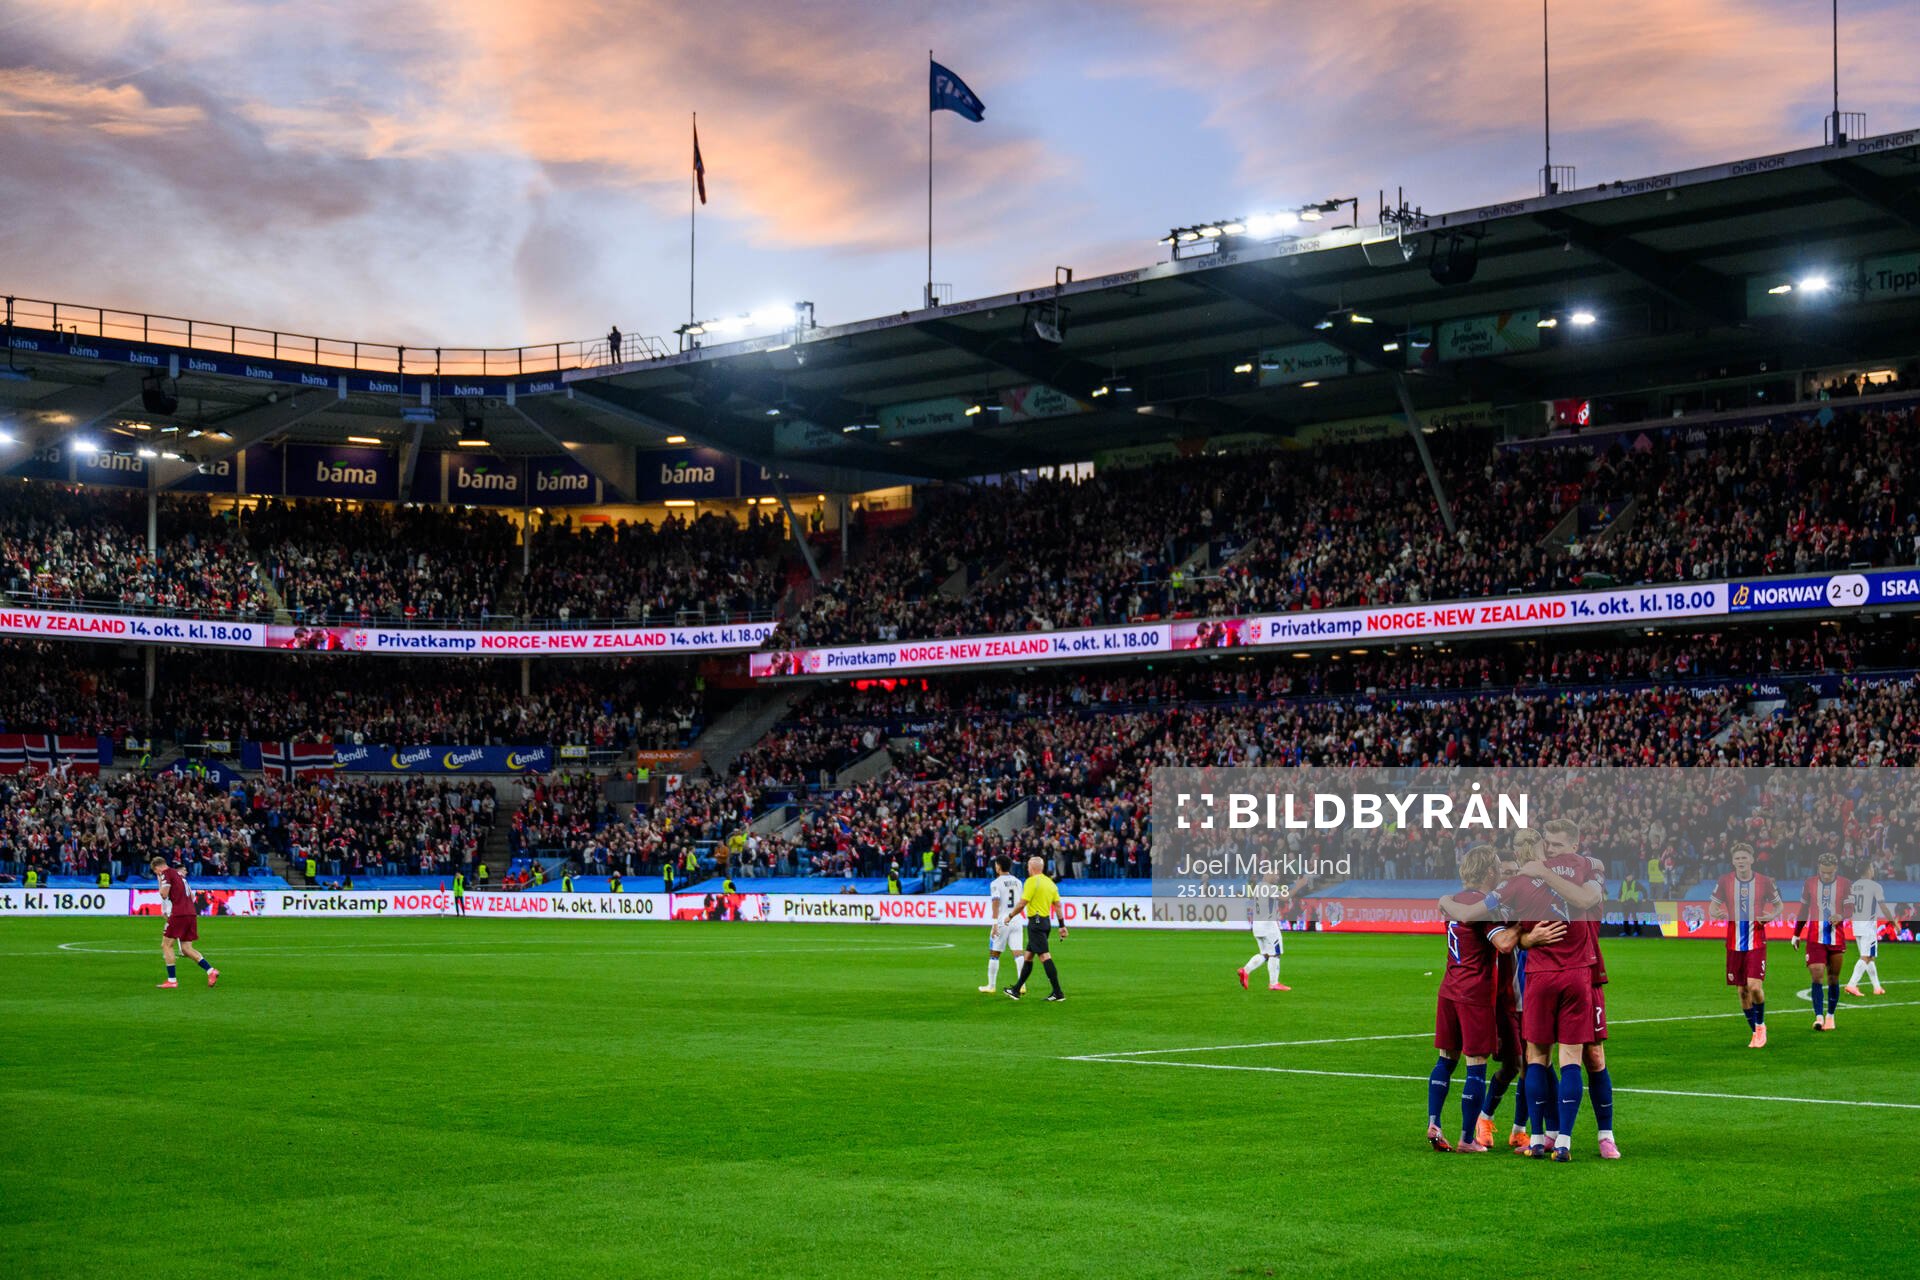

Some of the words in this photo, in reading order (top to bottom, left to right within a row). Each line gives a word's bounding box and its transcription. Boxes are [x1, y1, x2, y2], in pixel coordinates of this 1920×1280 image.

[316, 460, 377, 485] bama
[458, 467, 517, 491] bama
[536, 470, 588, 491] bama
[661, 463, 715, 484] bama
[1754, 585, 1823, 605] NORWAY
[1271, 618, 1362, 638] Privatkamp
[1367, 607, 1476, 632] NORGE-NEW
[1481, 601, 1566, 624] ZEALAND
[1570, 600, 1595, 617] 14.
[1598, 596, 1635, 615] okt.
[1640, 594, 1662, 613] kl.
[1666, 590, 1715, 611] 18.00
[1, 613, 41, 630] NEW
[46, 615, 126, 634] ZEALAND
[130, 621, 151, 636] 14.
[154, 622, 184, 638] okt.
[189, 624, 208, 639] kl.
[211, 625, 252, 641] 18.00
[378, 633, 476, 651] Privatkamp
[481, 635, 588, 649] NORGE-NEW
[593, 633, 667, 648] ZEALAND
[670, 631, 690, 646] 14.
[693, 630, 718, 645] okt.
[721, 629, 736, 643] kl.
[739, 628, 771, 642] 18.00
[827, 650, 896, 667] Privatkamp
[900, 643, 983, 663] NORGE-NEW
[985, 638, 1049, 657] ZEALAND
[1053, 637, 1070, 653] 14.
[1074, 635, 1100, 652] okt.
[1104, 634, 1120, 649] kl.
[1123, 631, 1159, 647] 18.00
[337, 747, 368, 763] Bendit
[401, 747, 432, 763] Bendit
[453, 747, 484, 764] Bendit
[515, 749, 545, 765] Bendit
[25, 893, 48, 909] kl.
[53, 893, 105, 910] 18.00
[282, 895, 388, 913] Privatkamp
[488, 896, 548, 913] ZEALAND
[552, 898, 569, 912] 14.
[572, 898, 596, 913] okt.
[601, 898, 616, 914] kl.
[618, 898, 653, 914] 18.00
[1007, 889, 1015, 908] 3
[784, 899, 874, 920] Privatkamp
[879, 900, 986, 919] NORGE-NEW
[1082, 903, 1106, 921] 14.
[1110, 903, 1147, 921] okt.
[1152, 904, 1174, 921] kl.
[1177, 904, 1228, 922] 18.00
